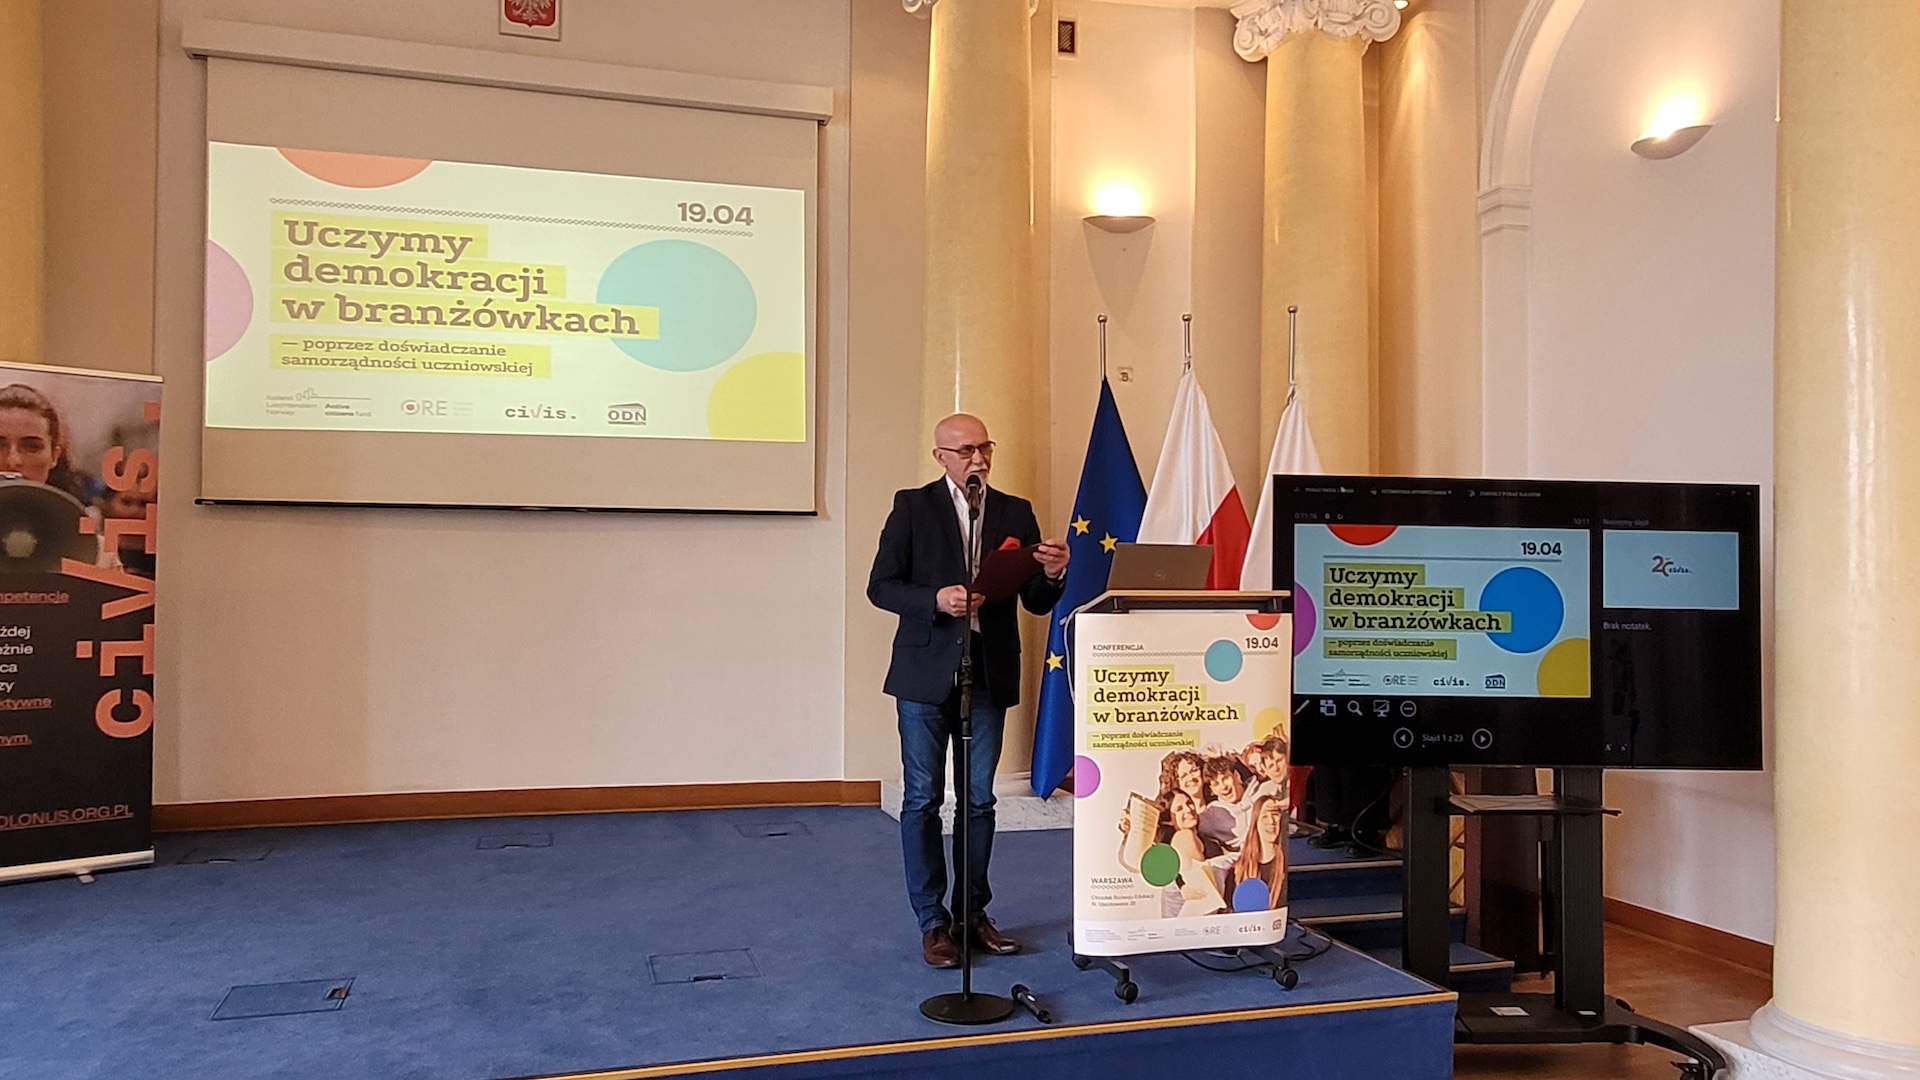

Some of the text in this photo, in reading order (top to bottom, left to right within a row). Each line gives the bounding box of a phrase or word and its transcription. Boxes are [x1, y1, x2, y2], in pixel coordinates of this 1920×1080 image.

[677, 202, 754, 227] 19.04
[284, 219, 473, 264] Uczymy
[284, 254, 548, 302] demokracji
[282, 293, 640, 335] w branżówkach
[303, 339, 374, 353] poprzez
[378, 340, 507, 356] doświadczanie
[281, 355, 533, 377] samorządności uczniowskiej
[607, 409, 647, 422] ODN
[1521, 541, 1563, 556] 19.04
[1329, 568, 1418, 590] Uczymy
[1329, 588, 1455, 612] demokracji
[1329, 610, 1502, 632] w branżówkach
[1603, 621, 1620, 630] Brak
[0, 625, 31, 640] żdej
[1092, 643, 1144, 651] KONFERENCJA
[1245, 636, 1279, 649] 19.04
[1338, 639, 1371, 648] poprzez
[1372, 639, 1435, 648] doświadczanie
[1328, 649, 1449, 660] samorządności uczniowskiej
[1093, 668, 1170, 688] Uczymy
[1093, 685, 1200, 706] demokracji
[1093, 704, 1239, 723] w branżówkach
[1092, 738, 1195, 750] samorządności uczniowskiej
[1101, 732, 1130, 741] poprzez
[1132, 730, 1183, 739] doświadczanie
